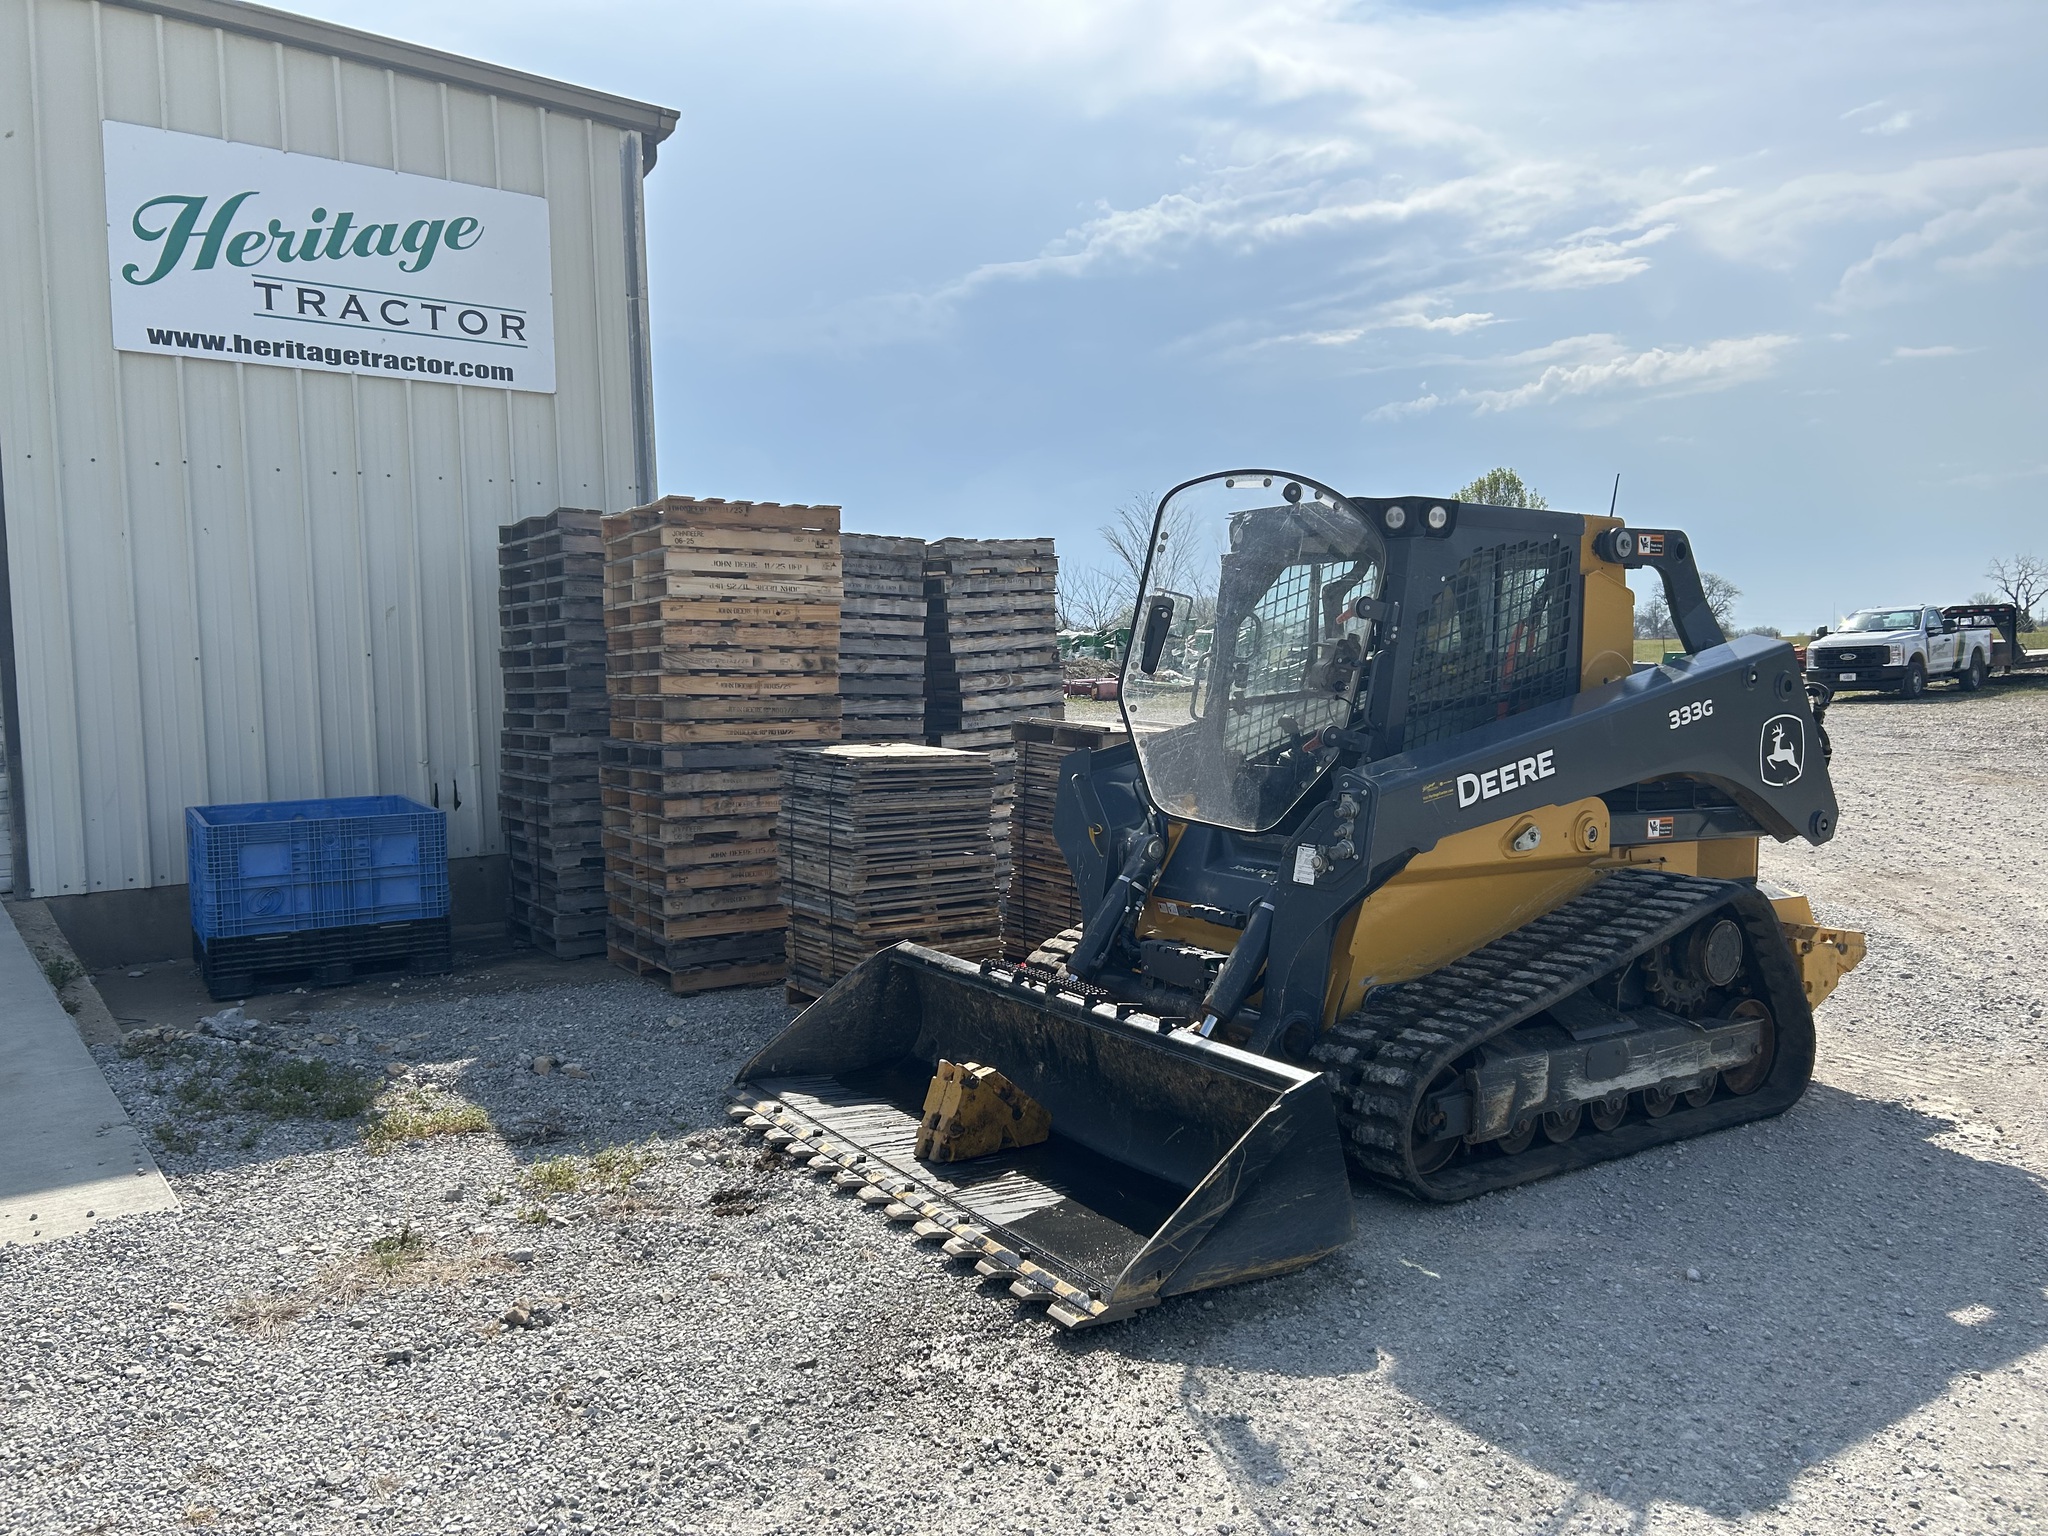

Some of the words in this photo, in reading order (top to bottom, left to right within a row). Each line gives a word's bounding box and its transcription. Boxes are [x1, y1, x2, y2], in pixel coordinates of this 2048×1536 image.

[122, 191, 484, 285] Heritage
[253, 280, 526, 341] TRACTOR
[147, 328, 514, 381] www.heritagetractor.com
[674, 537, 694, 545] 06-25
[1668, 699, 1714, 731] 333G
[1456, 748, 1556, 809] DEERE
